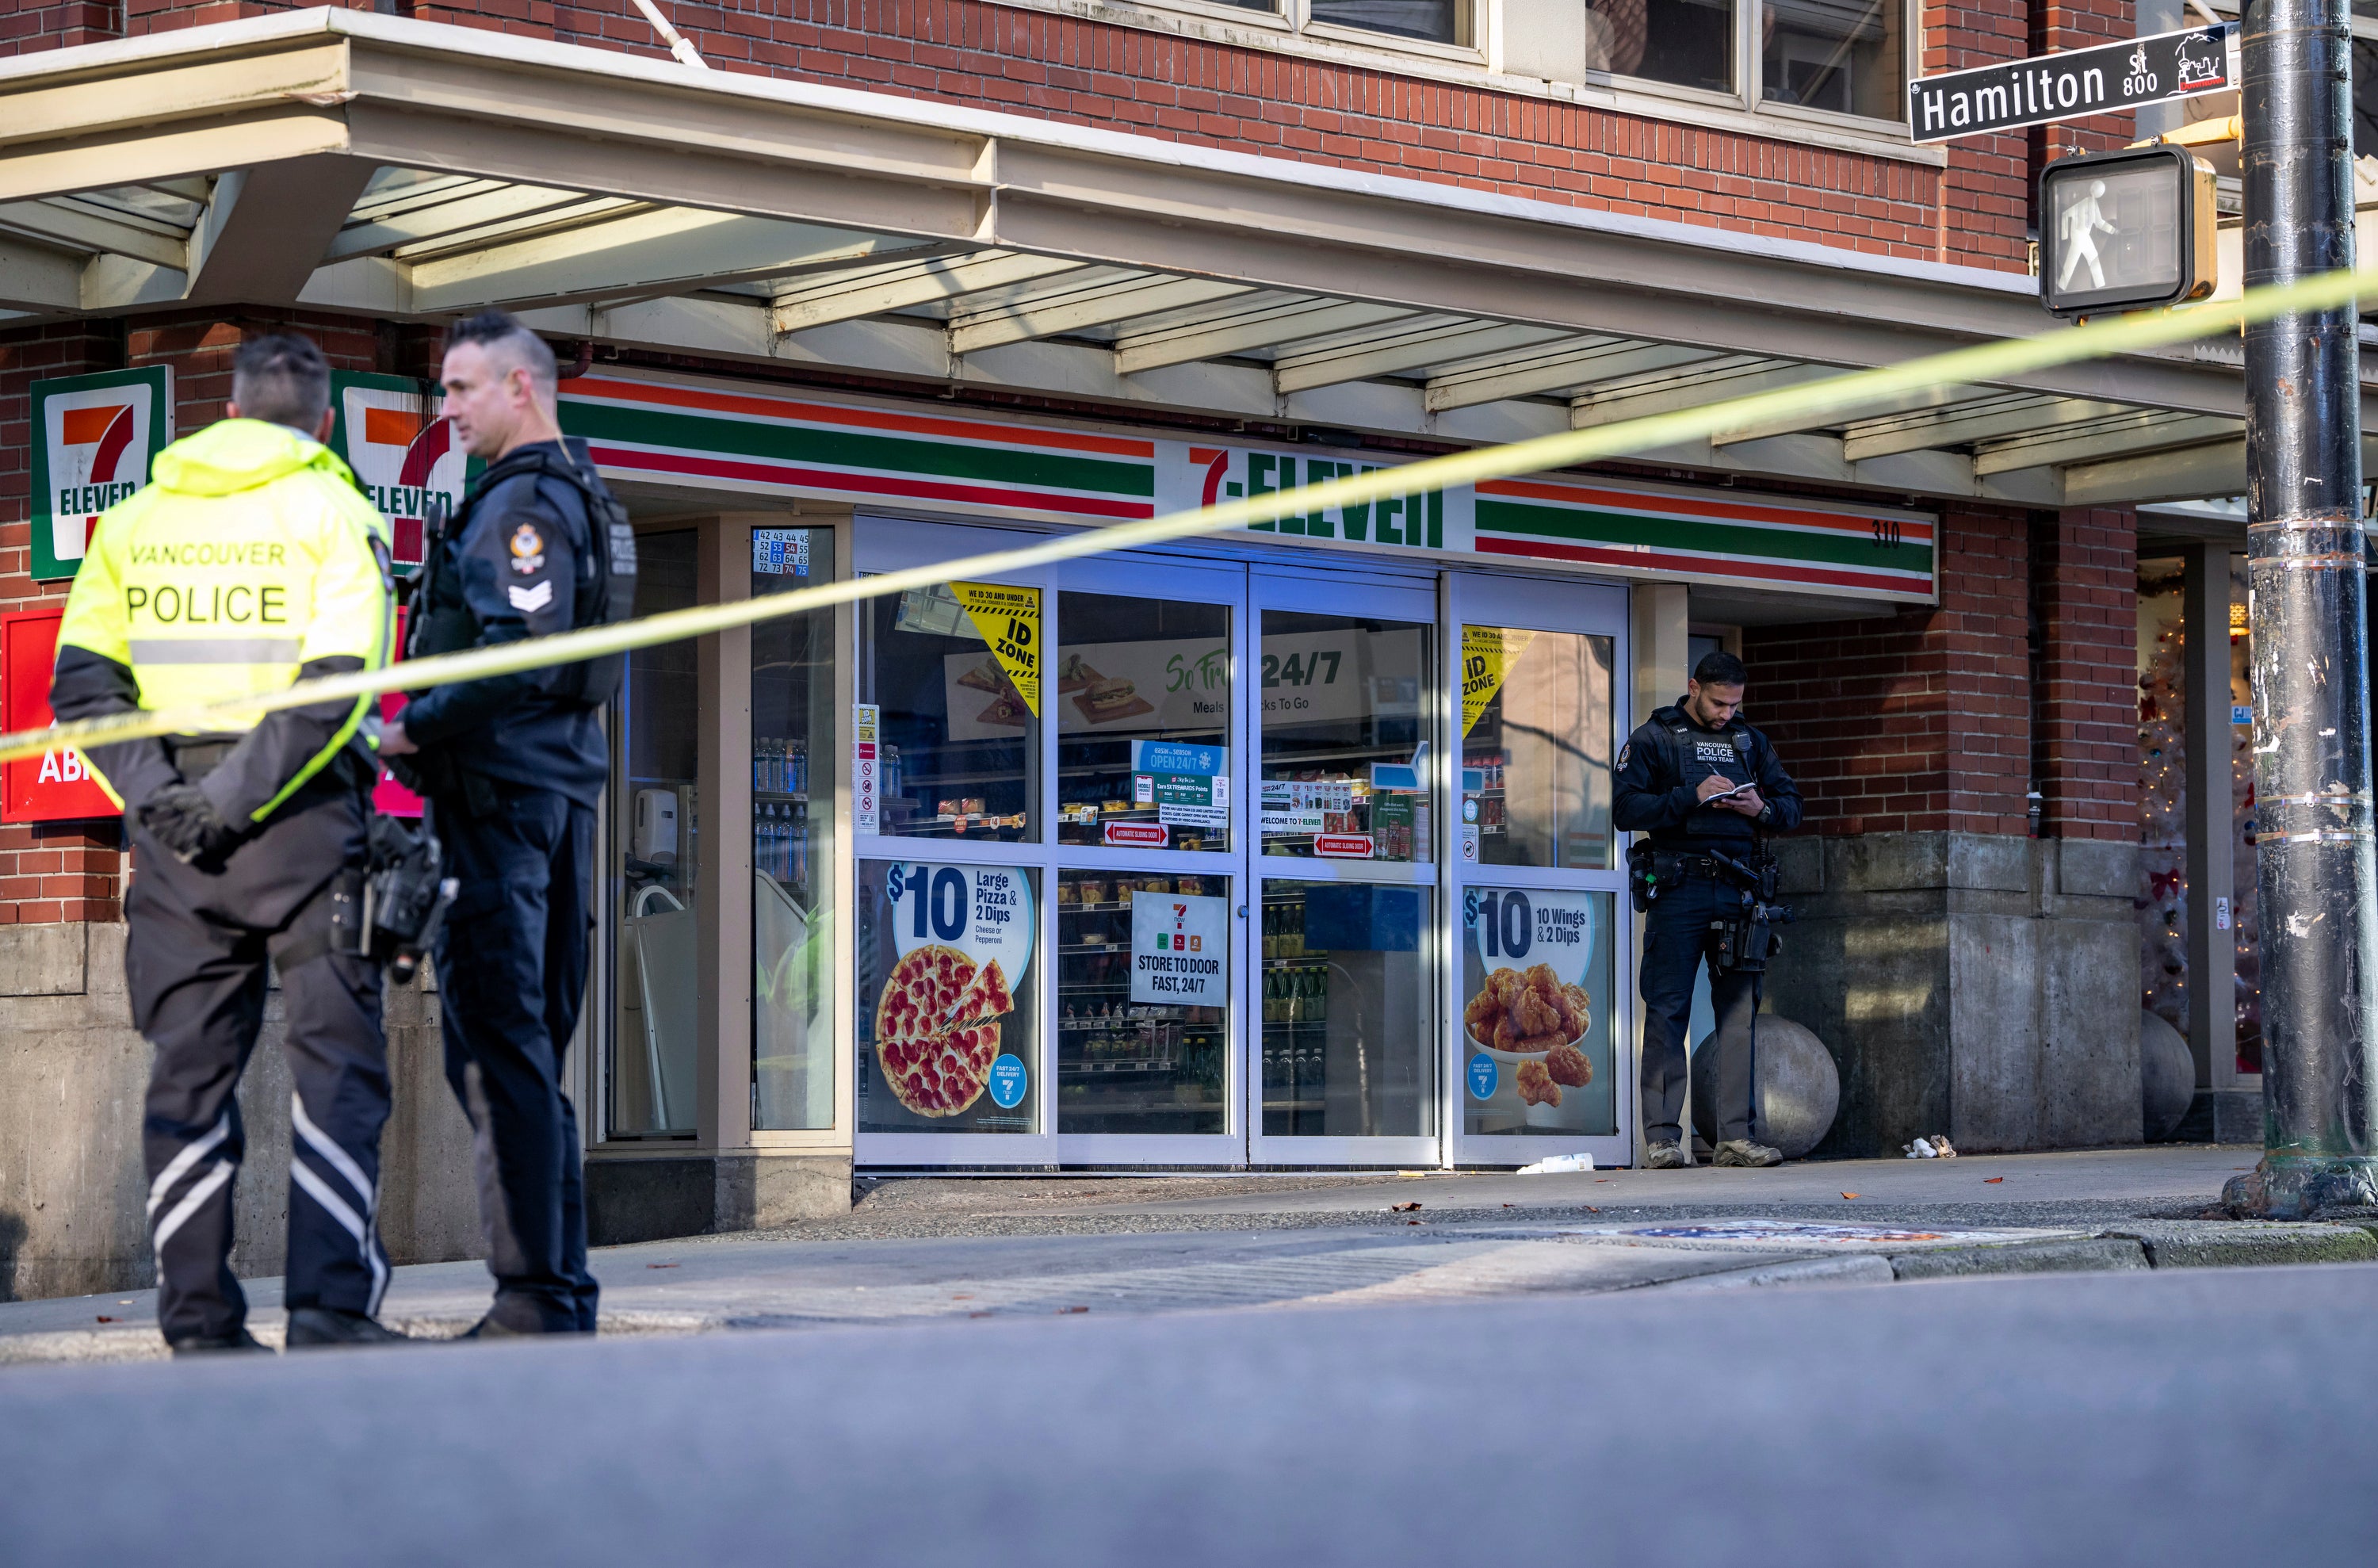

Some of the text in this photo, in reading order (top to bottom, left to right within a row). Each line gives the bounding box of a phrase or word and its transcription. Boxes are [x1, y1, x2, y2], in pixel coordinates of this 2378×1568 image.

[2123, 73, 2158, 96] 800
[2180, 76, 2225, 91] Downtown
[1923, 67, 2105, 132] Hamilton
[1872, 519, 1900, 549] 310
[130, 542, 285, 566] VANCOUVER
[774, 543, 782, 552] 53
[759, 563, 767, 572] 72
[798, 566, 806, 575] 75
[773, 553, 782, 562] 63
[799, 556, 807, 564] 65
[128, 587, 286, 622] POLICE
[1007, 618, 1032, 646] ID
[996, 637, 1035, 669] ZONE
[1166, 653, 1194, 693] So
[1261, 651, 1342, 688] 24/7
[1466, 655, 1485, 679] ID
[1462, 674, 1495, 696] ZONE
[1194, 701, 1224, 713] Meals
[1279, 698, 1290, 710] To
[1294, 697, 1309, 709] Go
[1151, 755, 1197, 770] OPEN 24/7
[1696, 748, 1734, 757] POLICE
[977, 870, 1008, 891] Large
[889, 864, 968, 942] $10
[976, 888, 1017, 905] Pizza &
[976, 905, 1010, 924] 2 Dips
[1466, 891, 1531, 958] $10
[1537, 908, 1585, 929] 10 Wings
[975, 925, 996, 934] Cheese
[975, 935, 1002, 945] Pepperoni
[1537, 927, 1580, 947] & 2 Dips
[1138, 954, 1219, 975] STORE TO DOOR
[1153, 975, 1205, 994] FAST, 24/7
